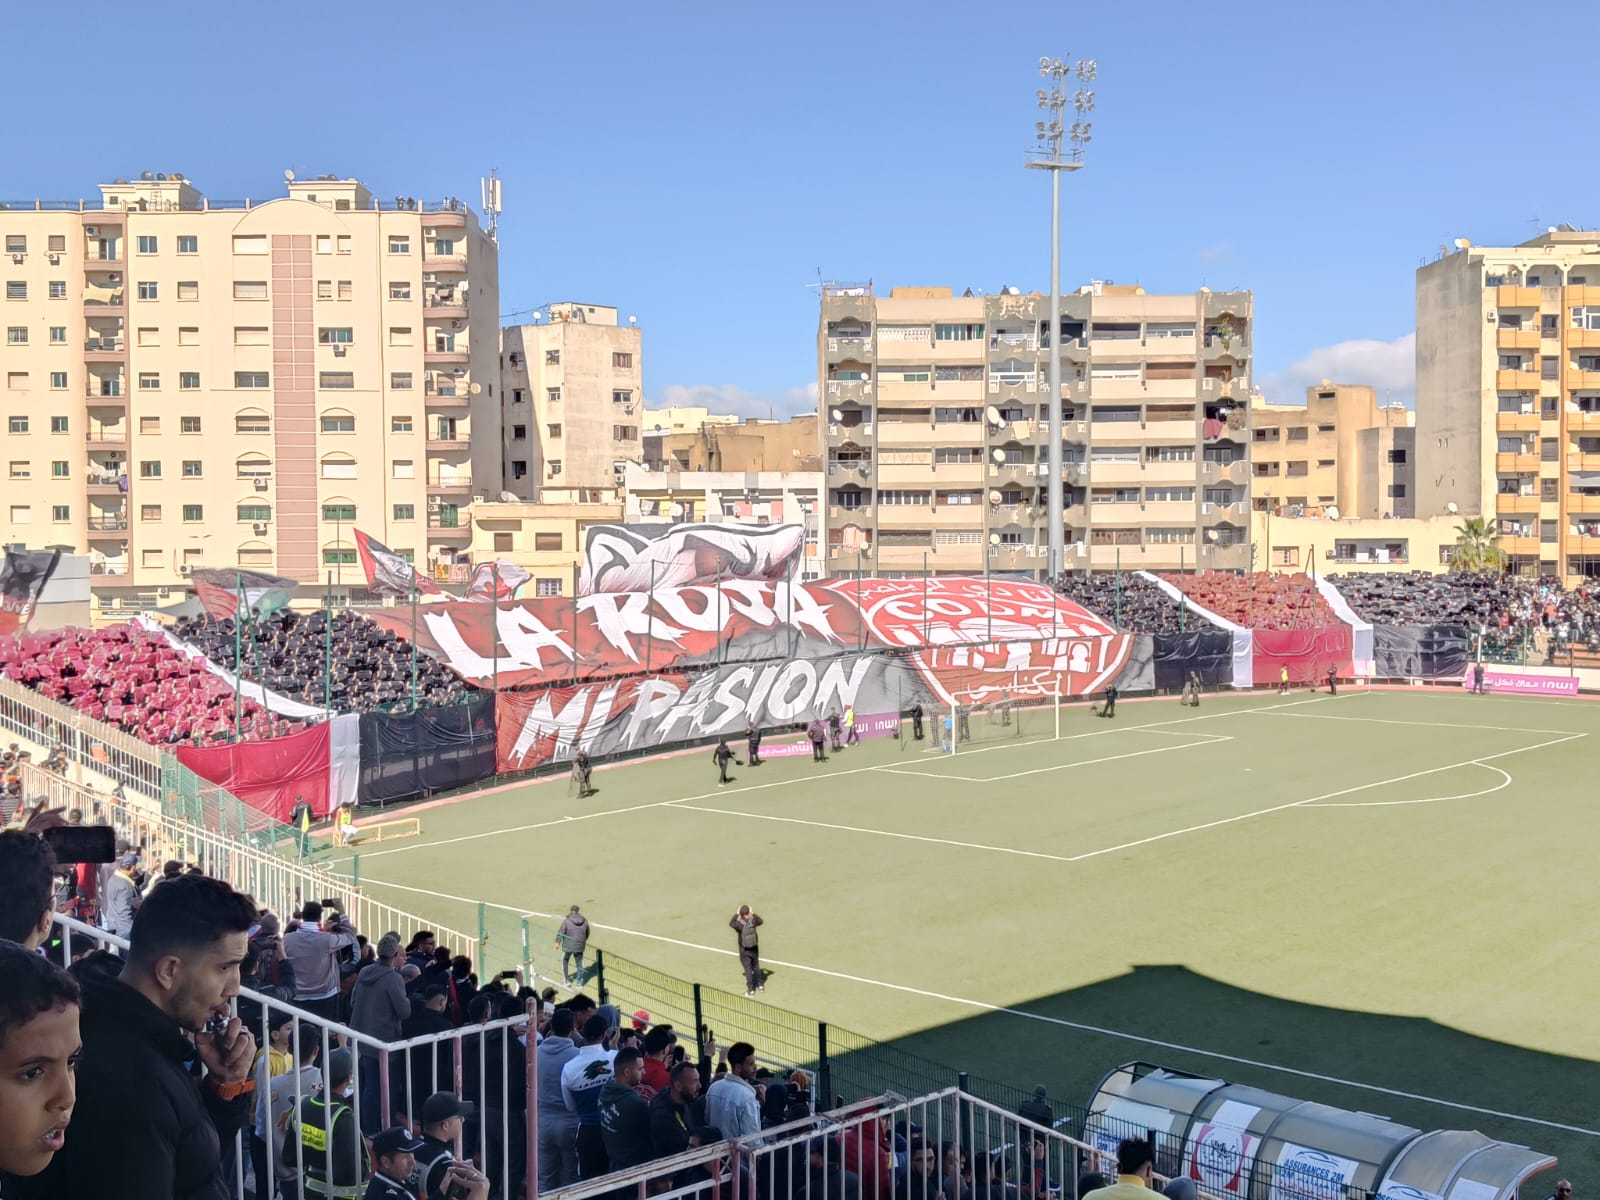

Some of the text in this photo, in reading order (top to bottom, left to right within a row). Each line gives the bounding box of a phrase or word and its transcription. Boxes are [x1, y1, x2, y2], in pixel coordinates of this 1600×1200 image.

[423, 577, 846, 681] LA ROJA
[507, 655, 876, 768] MI PASION
[1283, 1159, 1345, 1184] ASSURANCES 2M
